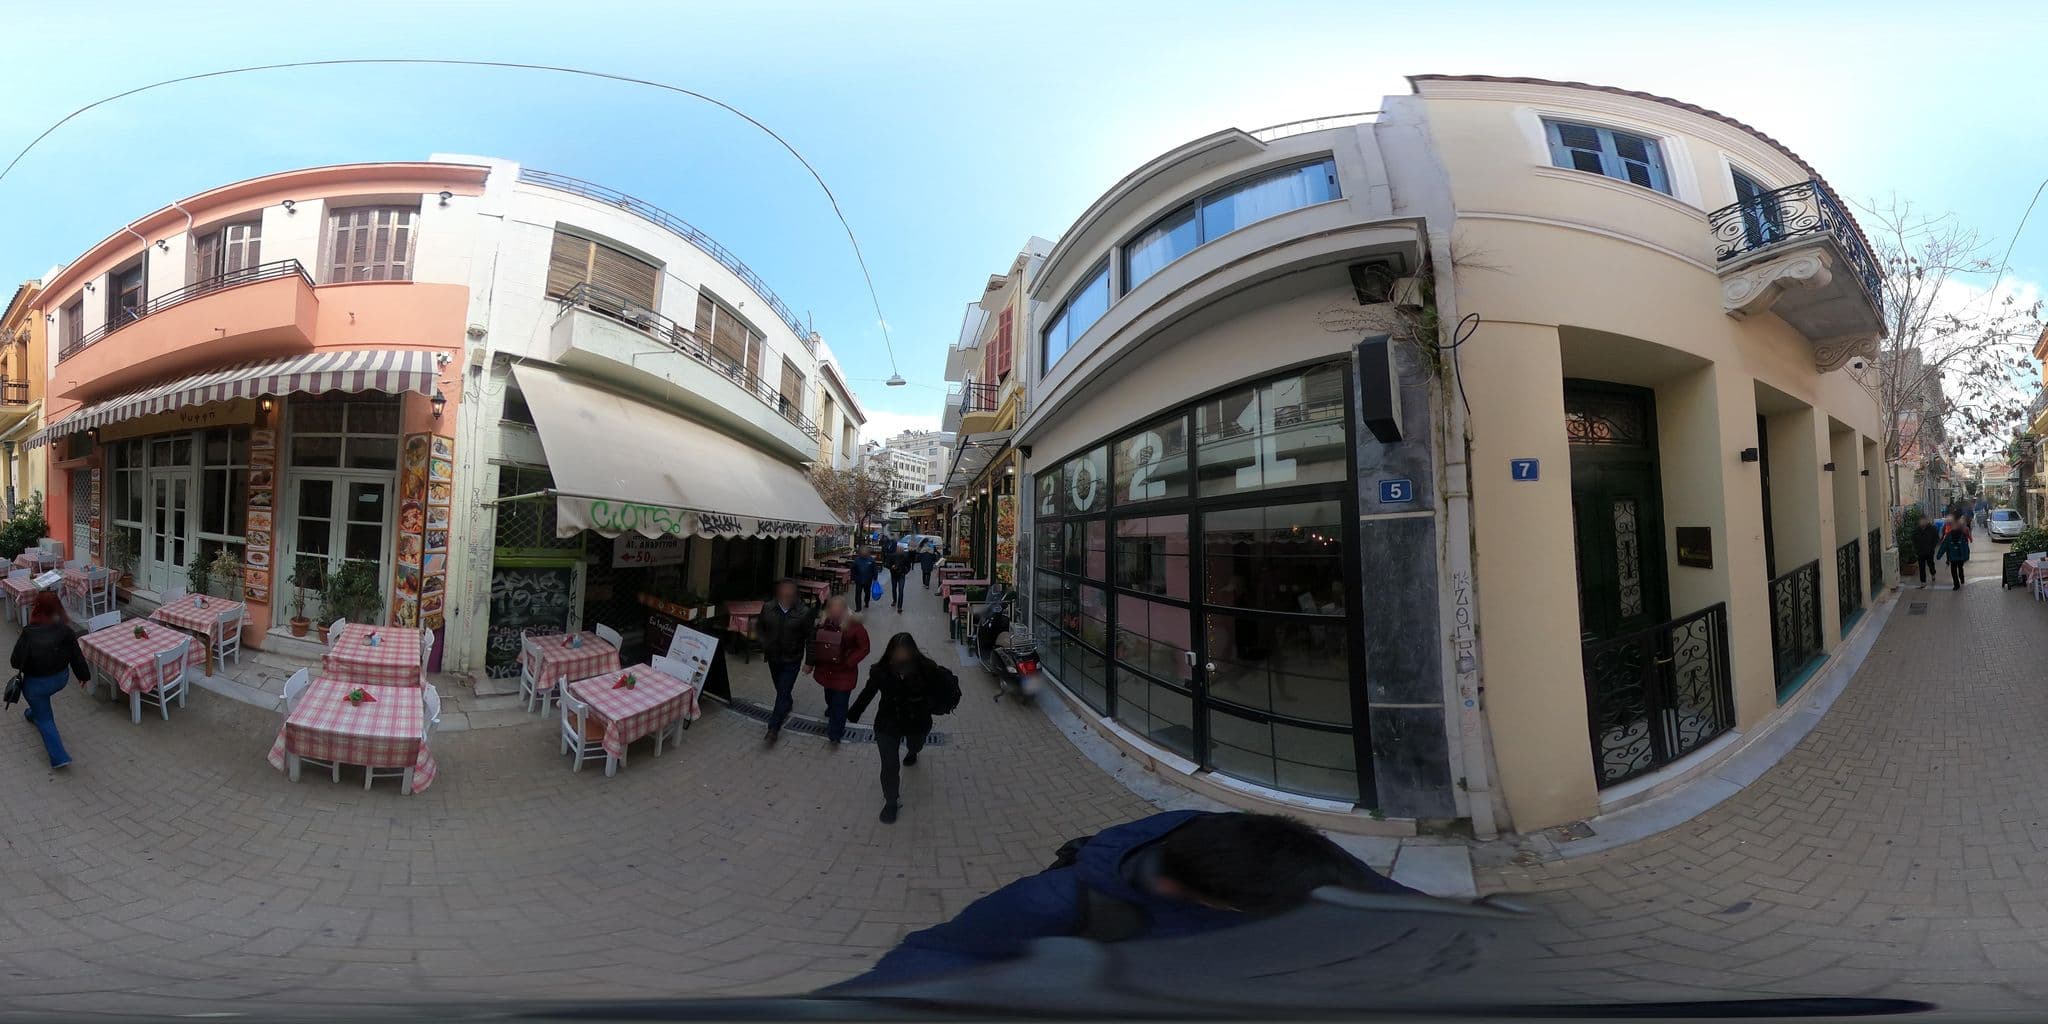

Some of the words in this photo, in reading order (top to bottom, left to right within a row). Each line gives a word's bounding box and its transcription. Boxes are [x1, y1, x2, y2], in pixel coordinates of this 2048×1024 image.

[1041, 387, 1297, 515] 2021
[1519, 462, 1530, 477] 7
[1390, 483, 1401, 499] 5
